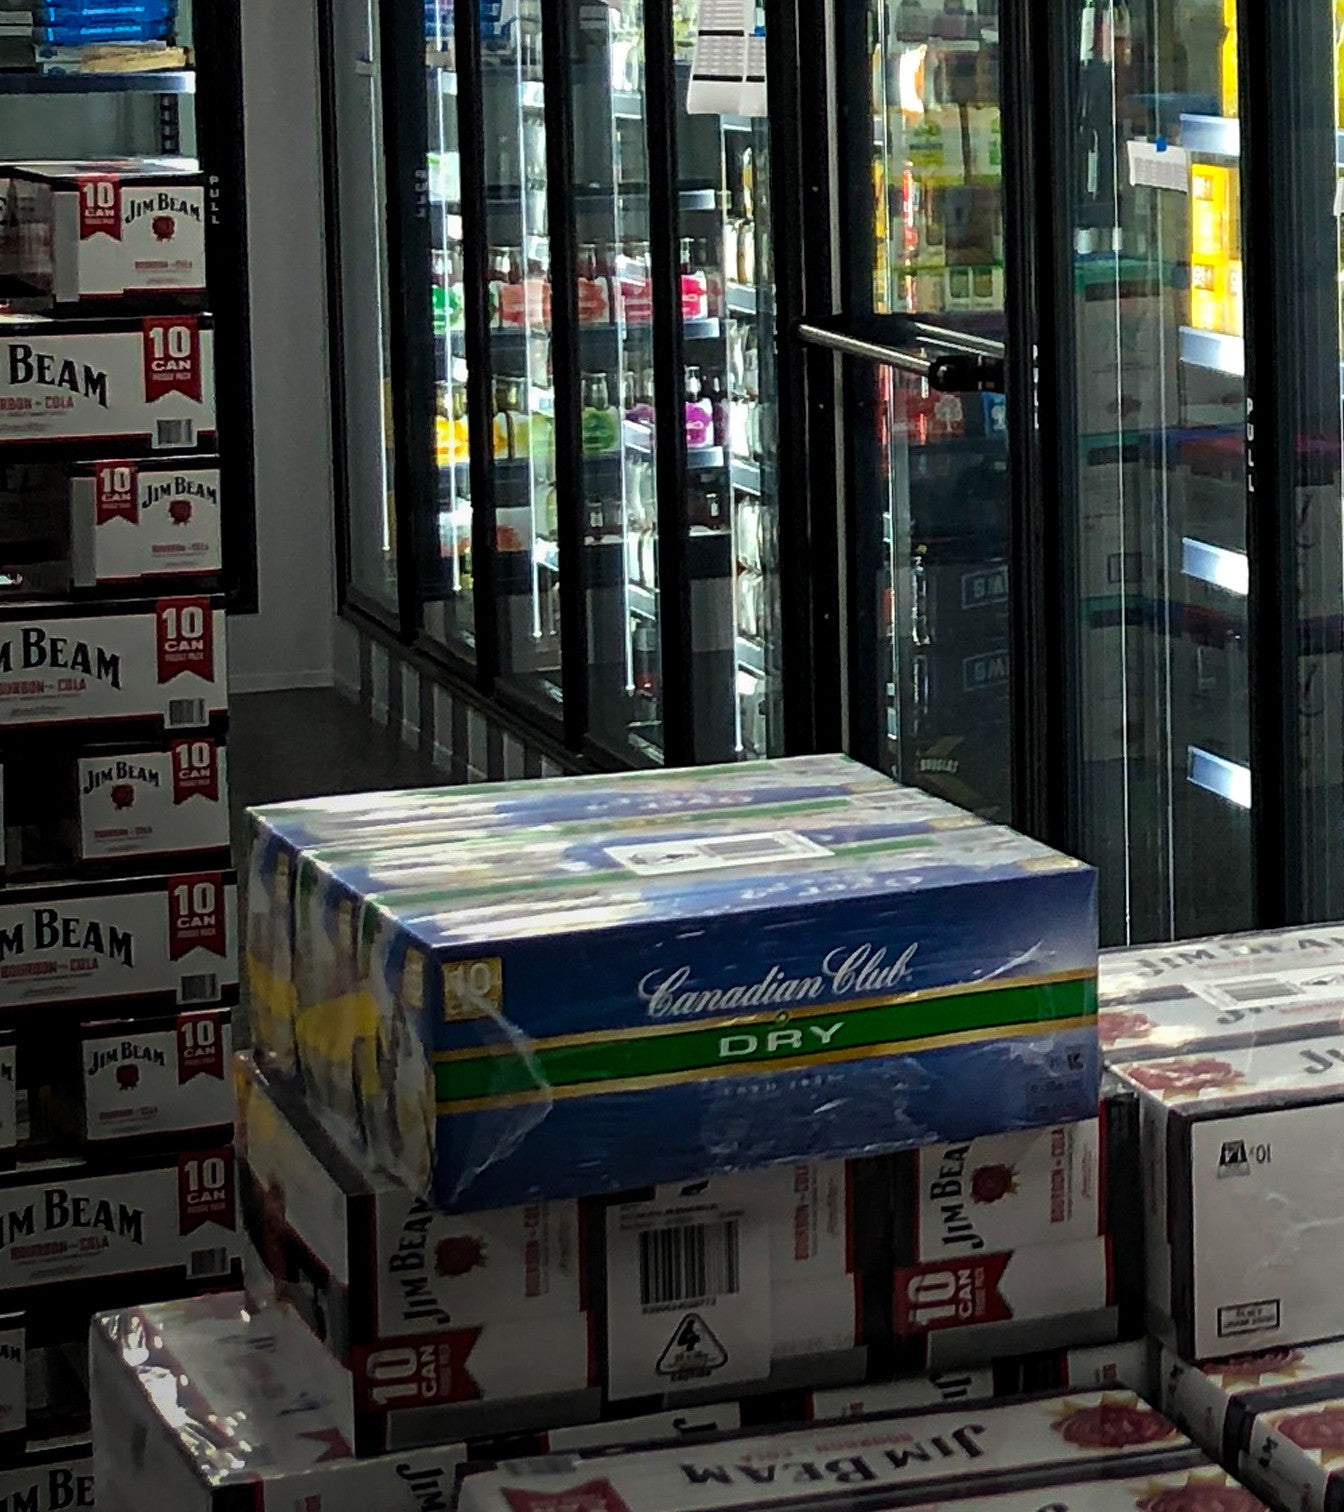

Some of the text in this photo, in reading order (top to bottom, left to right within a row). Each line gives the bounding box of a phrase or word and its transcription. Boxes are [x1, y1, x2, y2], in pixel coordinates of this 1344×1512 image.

[83, 182, 115, 207] 10
[125, 193, 201, 224] JIM BEAM
[209, 175, 221, 225] PULL
[149, 326, 192, 358] 10
[9, 344, 109, 408] BEAM
[151, 360, 192, 371] CAN
[100, 467, 131, 493] 10
[142, 477, 217, 509] JIM BEAM
[162, 606, 204, 638] 10
[21, 628, 121, 690] BEAM
[165, 640, 204, 651] CAN
[175, 741, 211, 768] 10
[84, 761, 160, 794] JIM BEAM
[174, 881, 216, 916] 10
[34, 908, 134, 968] BEAM
[177, 916, 216, 929] CAN
[1134, 948, 1216, 978] JIM
[638, 965, 824, 1020] Canadian
[183, 1020, 216, 1047] 10
[719, 1021, 846, 1058] DRY
[89, 1041, 166, 1076] JIM BEAM
[184, 1157, 226, 1192] 10
[187, 1190, 226, 1205] CAN
[930, 1145, 984, 1250] JIM BEA
[45, 1189, 144, 1246] BEAM
[402, 1275, 451, 1325] JIM
[906, 1270, 957, 1326] 10
[957, 1268, 974, 1318] CAN
[366, 1348, 419, 1406] 10
[420, 1344, 438, 1399] CAN
[679, 1423, 989, 1486] JIM BEAM
[49, 1468, 95, 1511] BE
